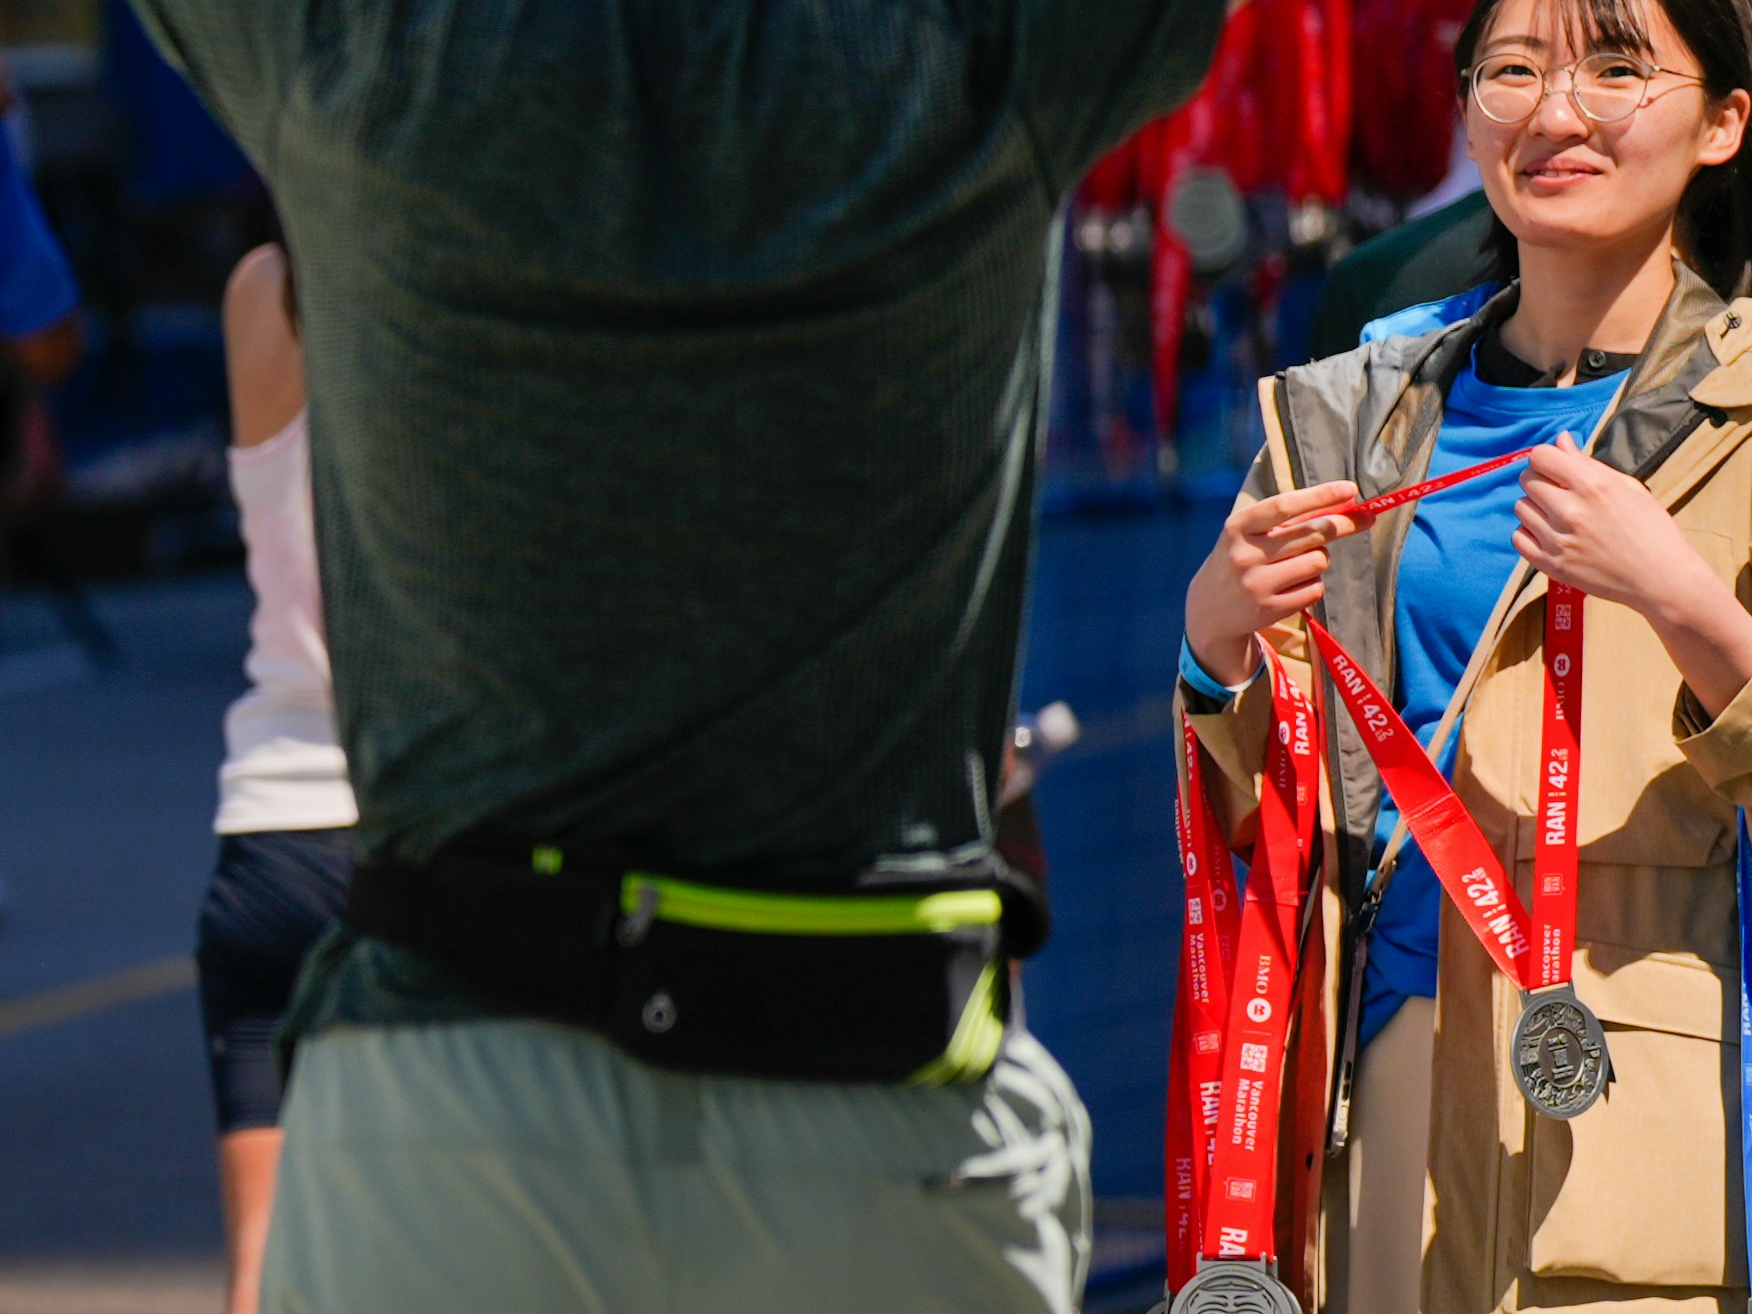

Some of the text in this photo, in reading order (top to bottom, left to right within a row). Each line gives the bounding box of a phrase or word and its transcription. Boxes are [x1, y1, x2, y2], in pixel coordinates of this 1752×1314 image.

[1332, 655, 1366, 696] RAN
[1546, 802, 1566, 845] RAN
[1190, 934, 1200, 1000] Marathon
[1196, 933, 1210, 1004] Vancouver
[1256, 955, 1271, 994] BMO
[1551, 929, 1560, 982] arathon
[1232, 1078, 1250, 1145] Marathon
[1244, 1080, 1263, 1151] Vancouver
[1219, 1227, 1248, 1259] RA
